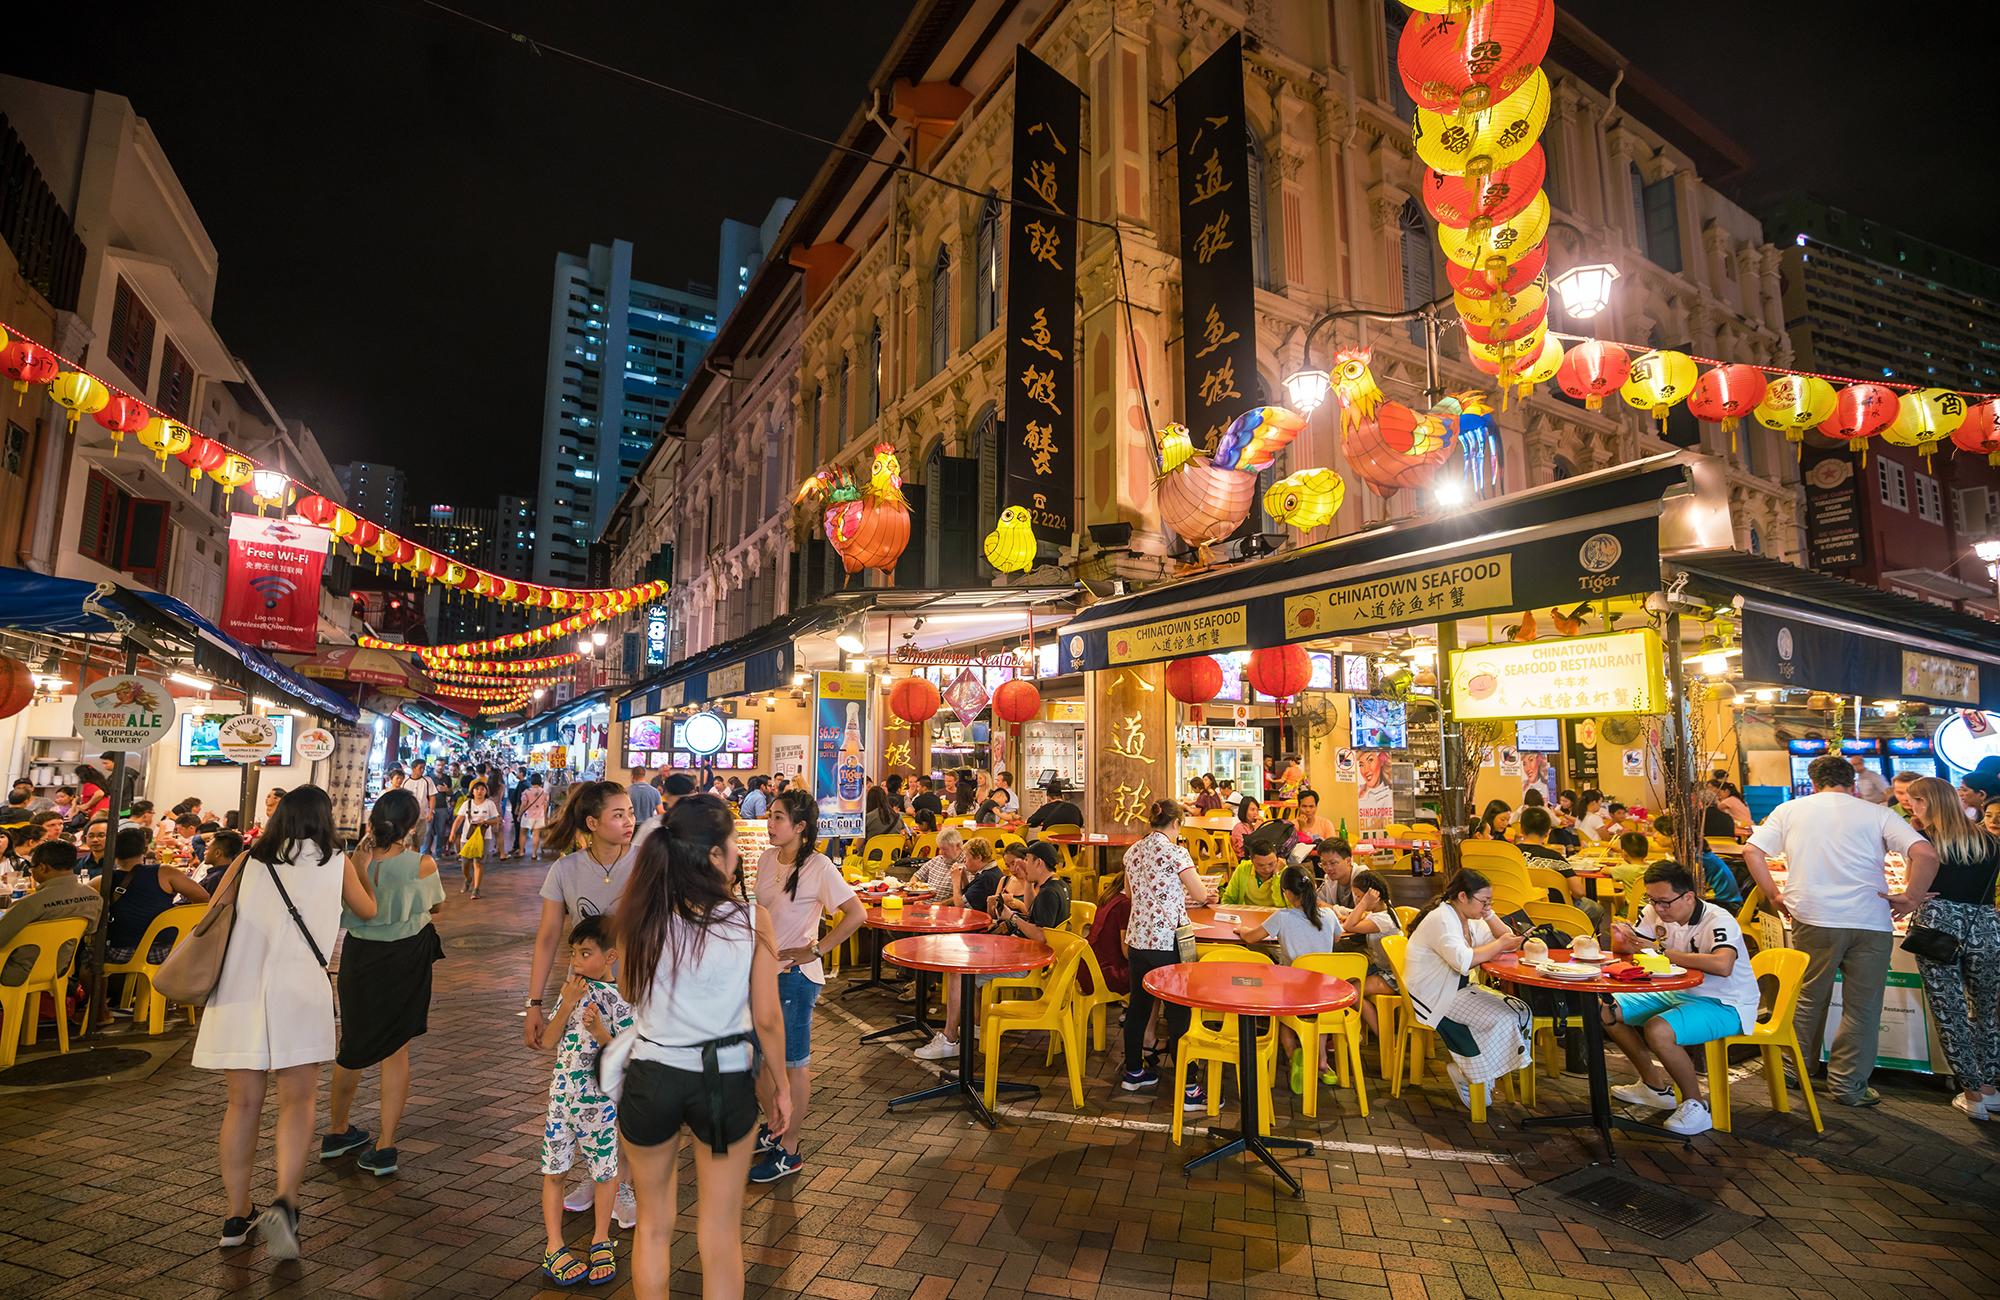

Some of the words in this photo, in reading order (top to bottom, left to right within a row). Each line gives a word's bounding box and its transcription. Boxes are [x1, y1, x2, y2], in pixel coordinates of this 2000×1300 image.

[1042, 511, 1067, 530] 2224
[247, 547, 274, 559] Free
[277, 550, 309, 564] Wi-Fi
[1821, 555, 1849, 564] LEVEL
[1850, 553, 1857, 561] 2
[1329, 577, 1417, 607] CHINATOWN
[1422, 562, 1501, 590] SEAFOOD
[1579, 574, 1620, 593] Tiger
[1354, 586, 1465, 621] 八道馆鱼虾蟹
[255, 613, 267, 622] Log
[230, 620, 304, 632] Wireless@Chinatown
[1136, 621, 1191, 640] CHINATOWN
[1194, 611, 1241, 631] SEAFOOD
[1532, 642, 1608, 659] CHINATOWN
[1070, 658, 1085, 670] Tiger
[1504, 661, 1557, 676] SEAFOOD
[1561, 653, 1644, 671] RESTAURANT
[83, 719, 125, 727] BLONDE
[126, 714, 162, 727] ALE
[223, 718, 272, 737] ARCHIPELAGO
[819, 727, 840, 739] $6.95
[840, 769, 863, 782] Tiger
[1359, 807, 1393, 817] SINGAPORE
[837, 819, 861, 828] COLD
[1713, 928, 1727, 942] 5
[1884, 1006, 1915, 1014] Restaurant
[775, 1156, 790, 1172] K
